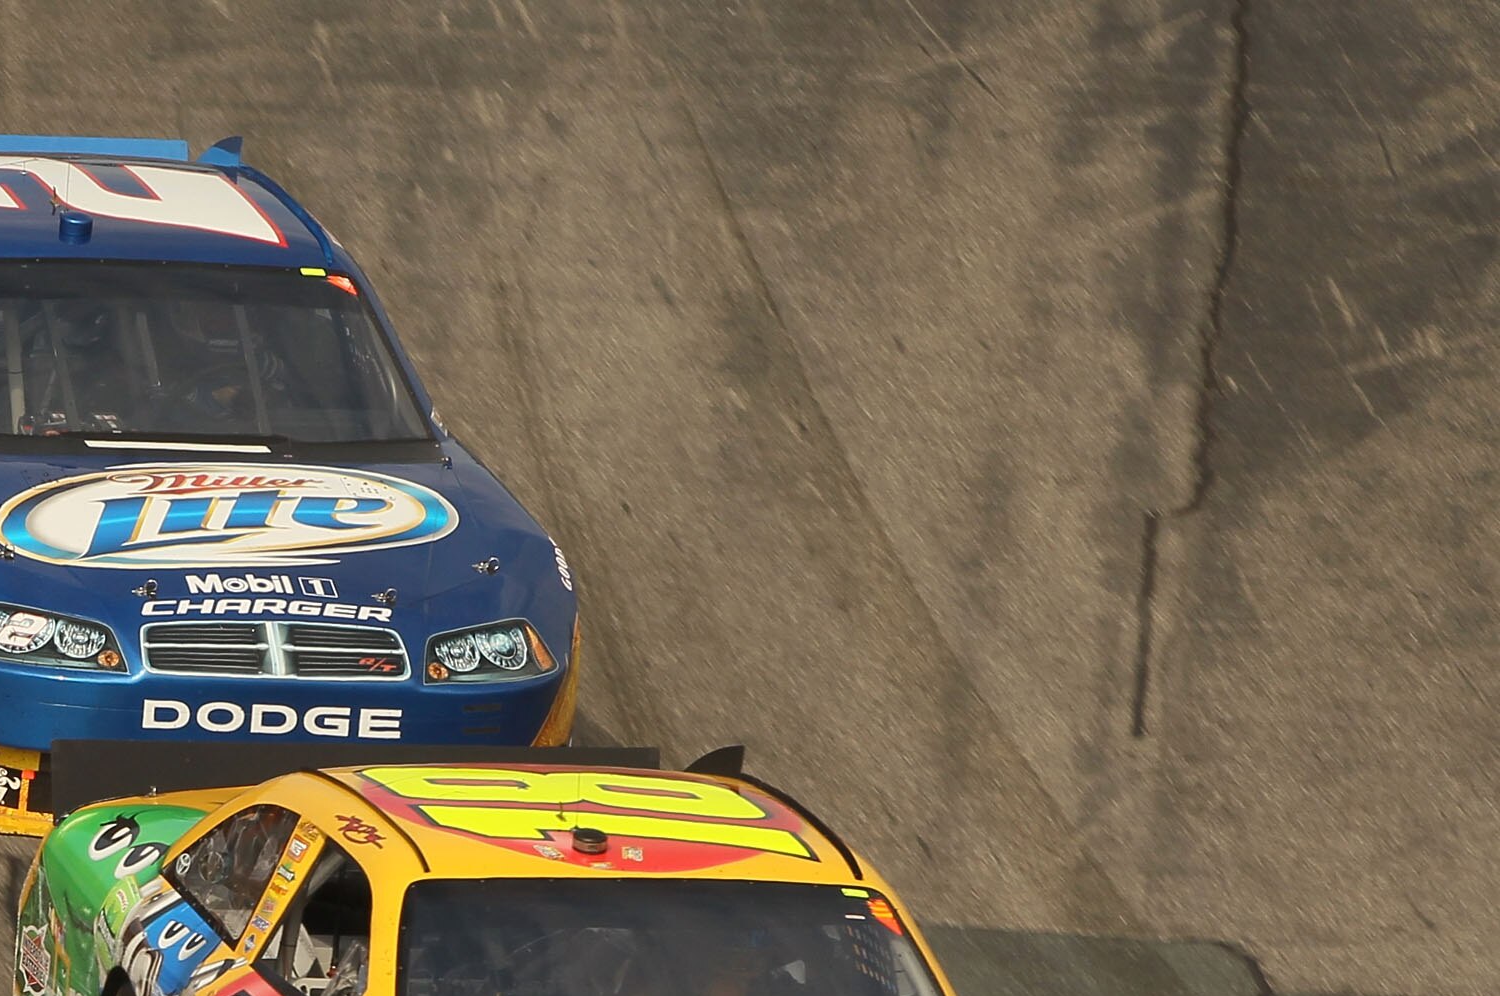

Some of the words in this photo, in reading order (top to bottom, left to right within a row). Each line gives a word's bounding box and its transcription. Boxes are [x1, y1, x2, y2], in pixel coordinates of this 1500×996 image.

[106, 473, 326, 495] Miller
[74, 489, 394, 557] Lite
[185, 573, 295, 596] Mobil
[141, 599, 393, 622] CHARGER
[141, 699, 403, 740] DODGE
[357, 764, 822, 863] 18
